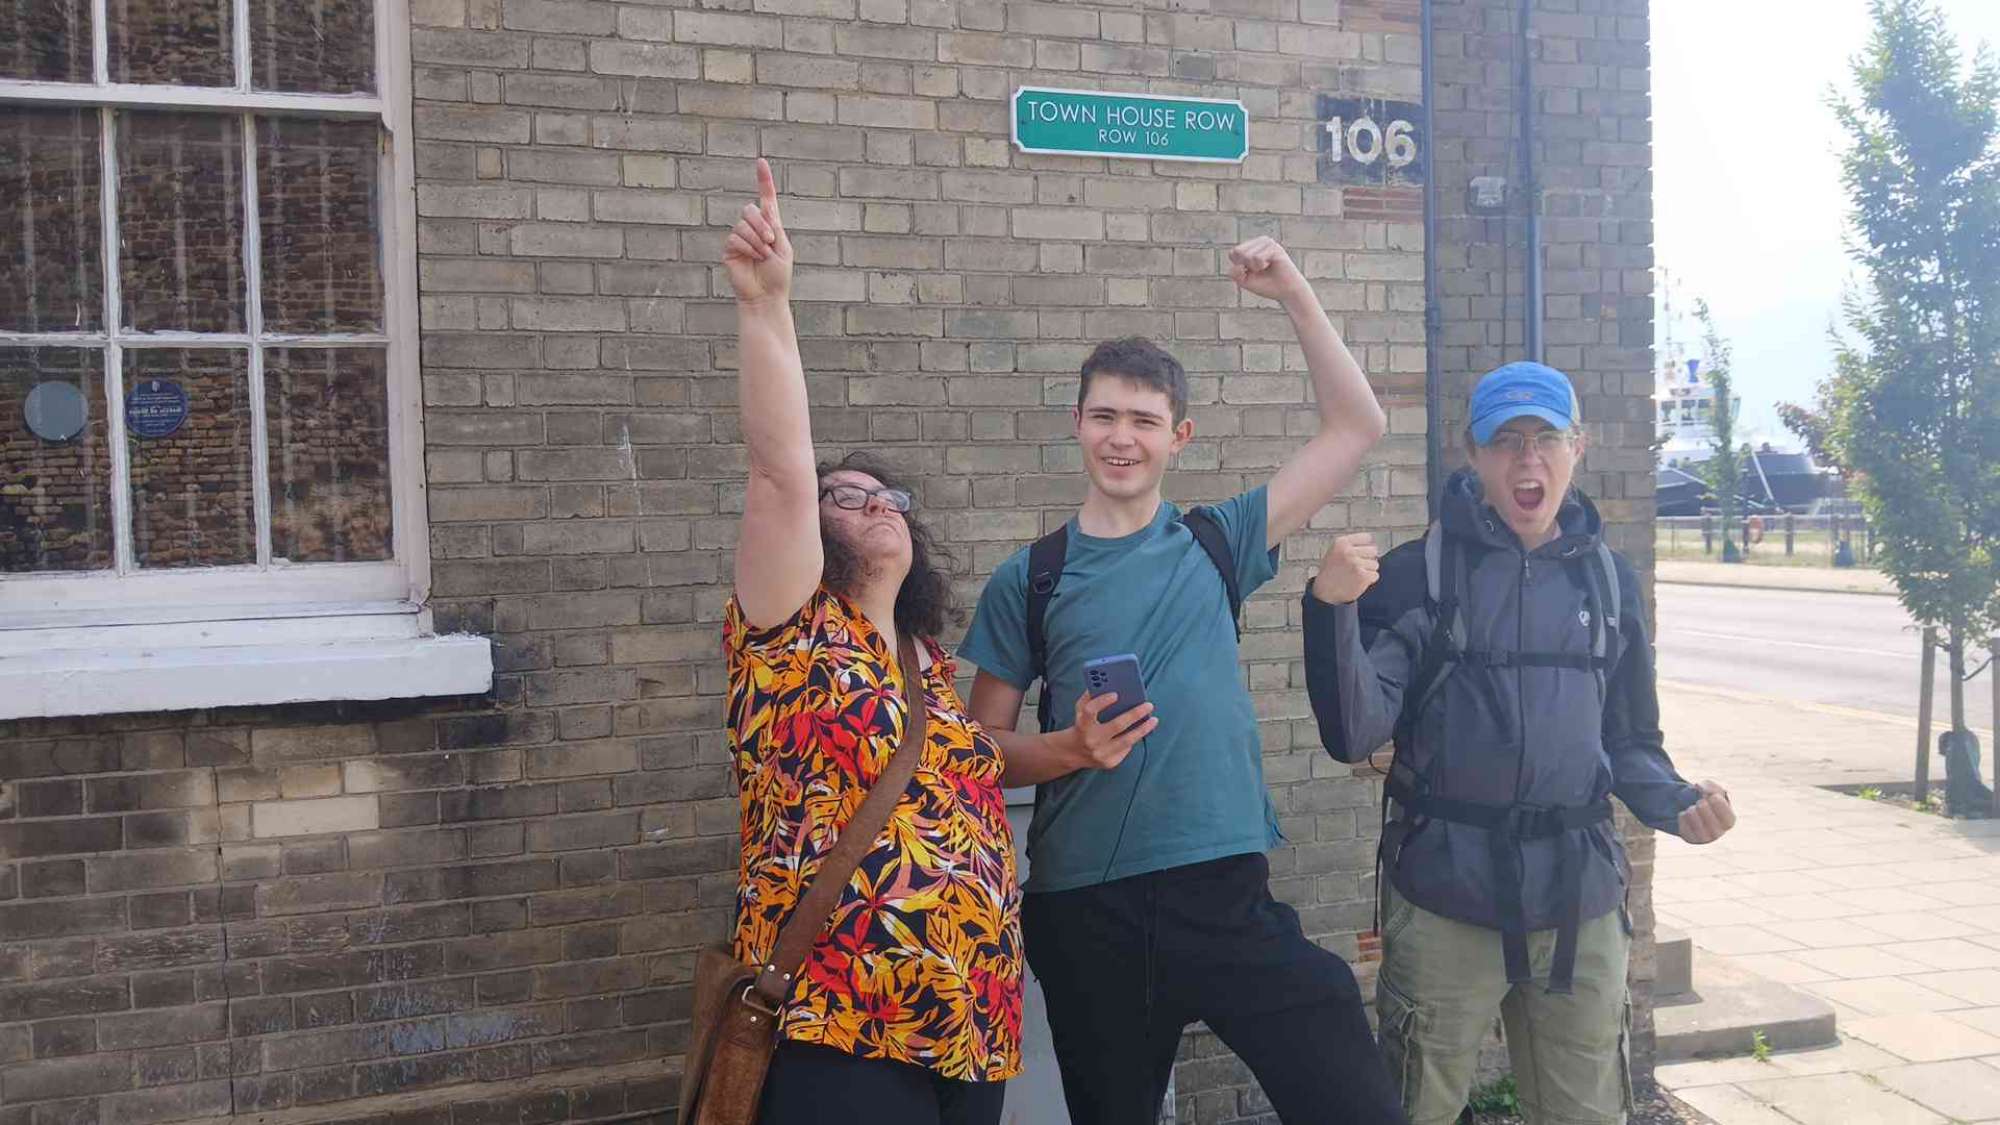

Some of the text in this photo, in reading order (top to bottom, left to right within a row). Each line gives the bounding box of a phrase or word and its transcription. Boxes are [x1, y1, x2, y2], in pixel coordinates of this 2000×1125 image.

[1028, 101, 1235, 131] TOWN HOUSE ROW
[1099, 129, 1169, 146] ROW 106
[1326, 116, 1417, 167] 106
